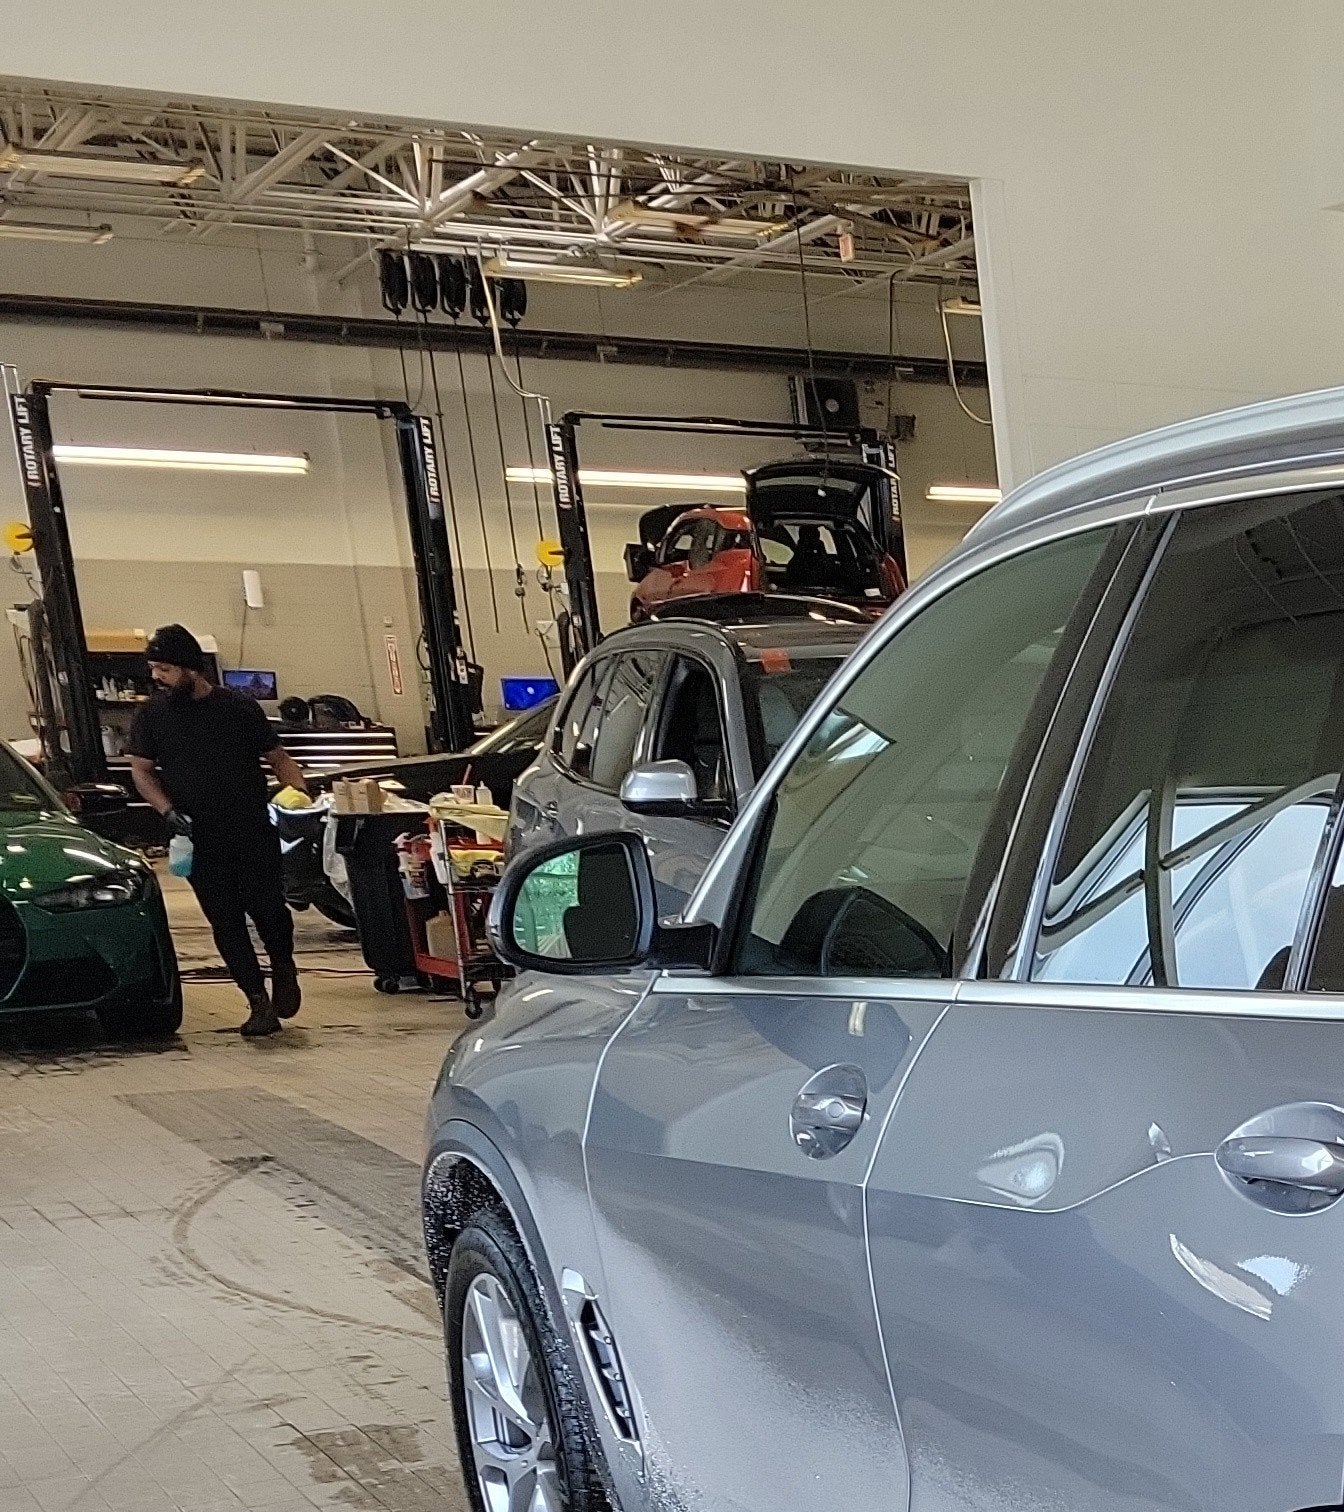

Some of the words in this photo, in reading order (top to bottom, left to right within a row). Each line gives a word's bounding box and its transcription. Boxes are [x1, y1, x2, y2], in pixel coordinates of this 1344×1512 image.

[14, 395, 29, 424] LIFT
[420, 417, 432, 444] LIFT
[550, 425, 563, 451] LIFT
[19, 427, 40, 480] ROTARY
[424, 446, 440, 496] ROTARY
[553, 453, 571, 502] ROTARY
